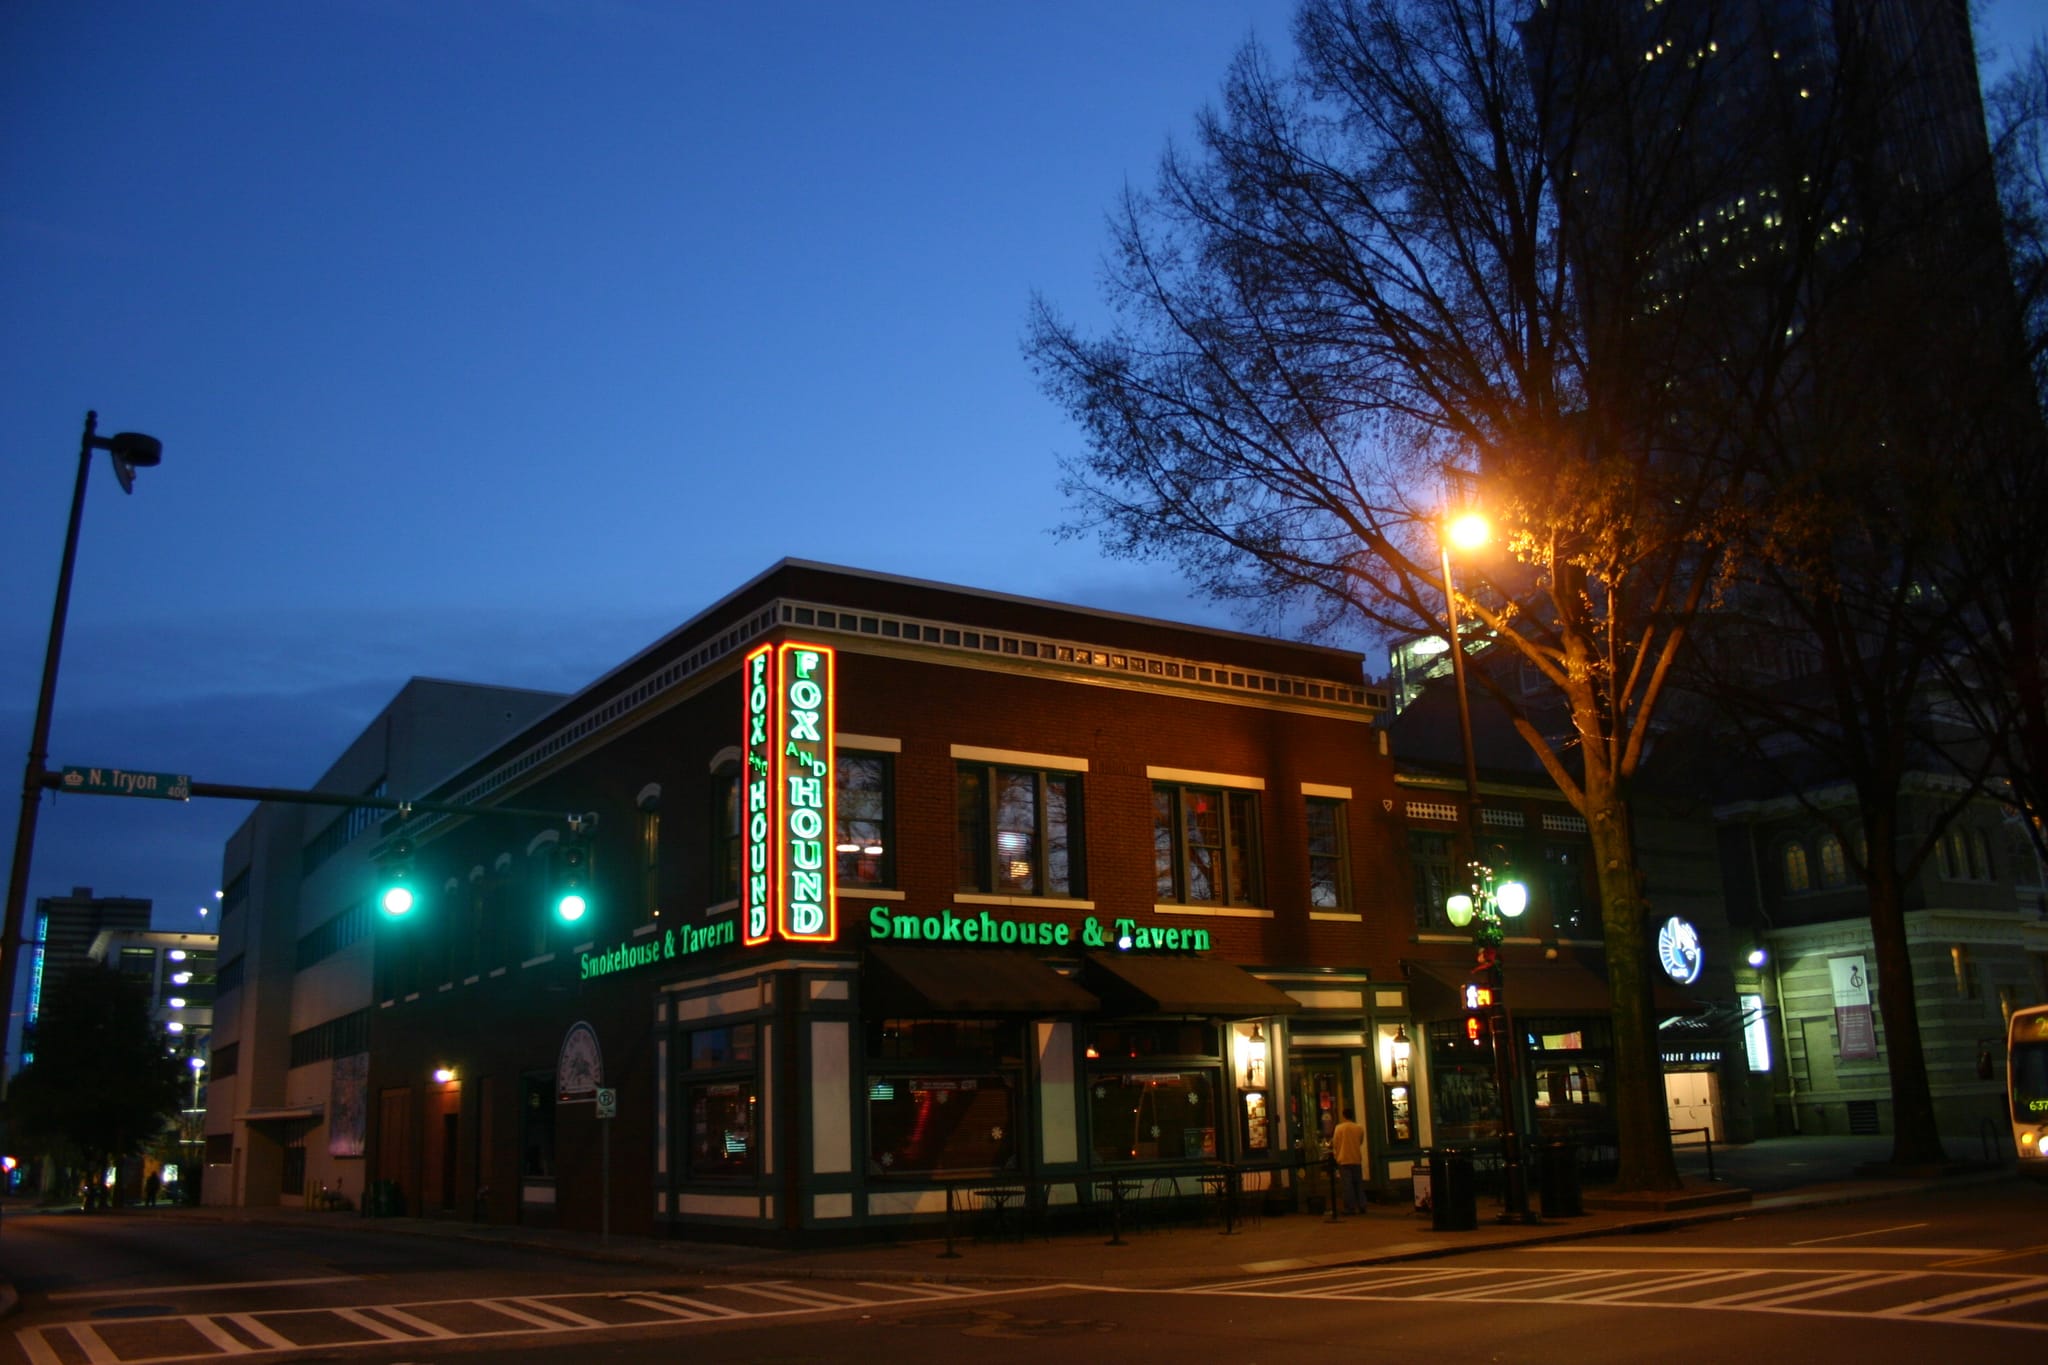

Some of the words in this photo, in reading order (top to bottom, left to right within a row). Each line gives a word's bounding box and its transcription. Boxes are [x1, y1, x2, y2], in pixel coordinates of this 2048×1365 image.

[750, 653, 767, 746] FOX
[789, 650, 822, 741] FOX
[112, 769, 157, 793] Tryon
[785, 741, 827, 777] AND
[167, 785, 188, 798] 400
[749, 779, 767, 938] HOUND
[788, 776, 824, 934] HOUND
[581, 940, 659, 980] Smokehouse
[664, 929, 675, 959] &
[681, 919, 734, 955] Tavern
[869, 905, 1070, 946] Smokehouse
[1082, 916, 1104, 946] &
[1115, 917, 1210, 950] Tavern
